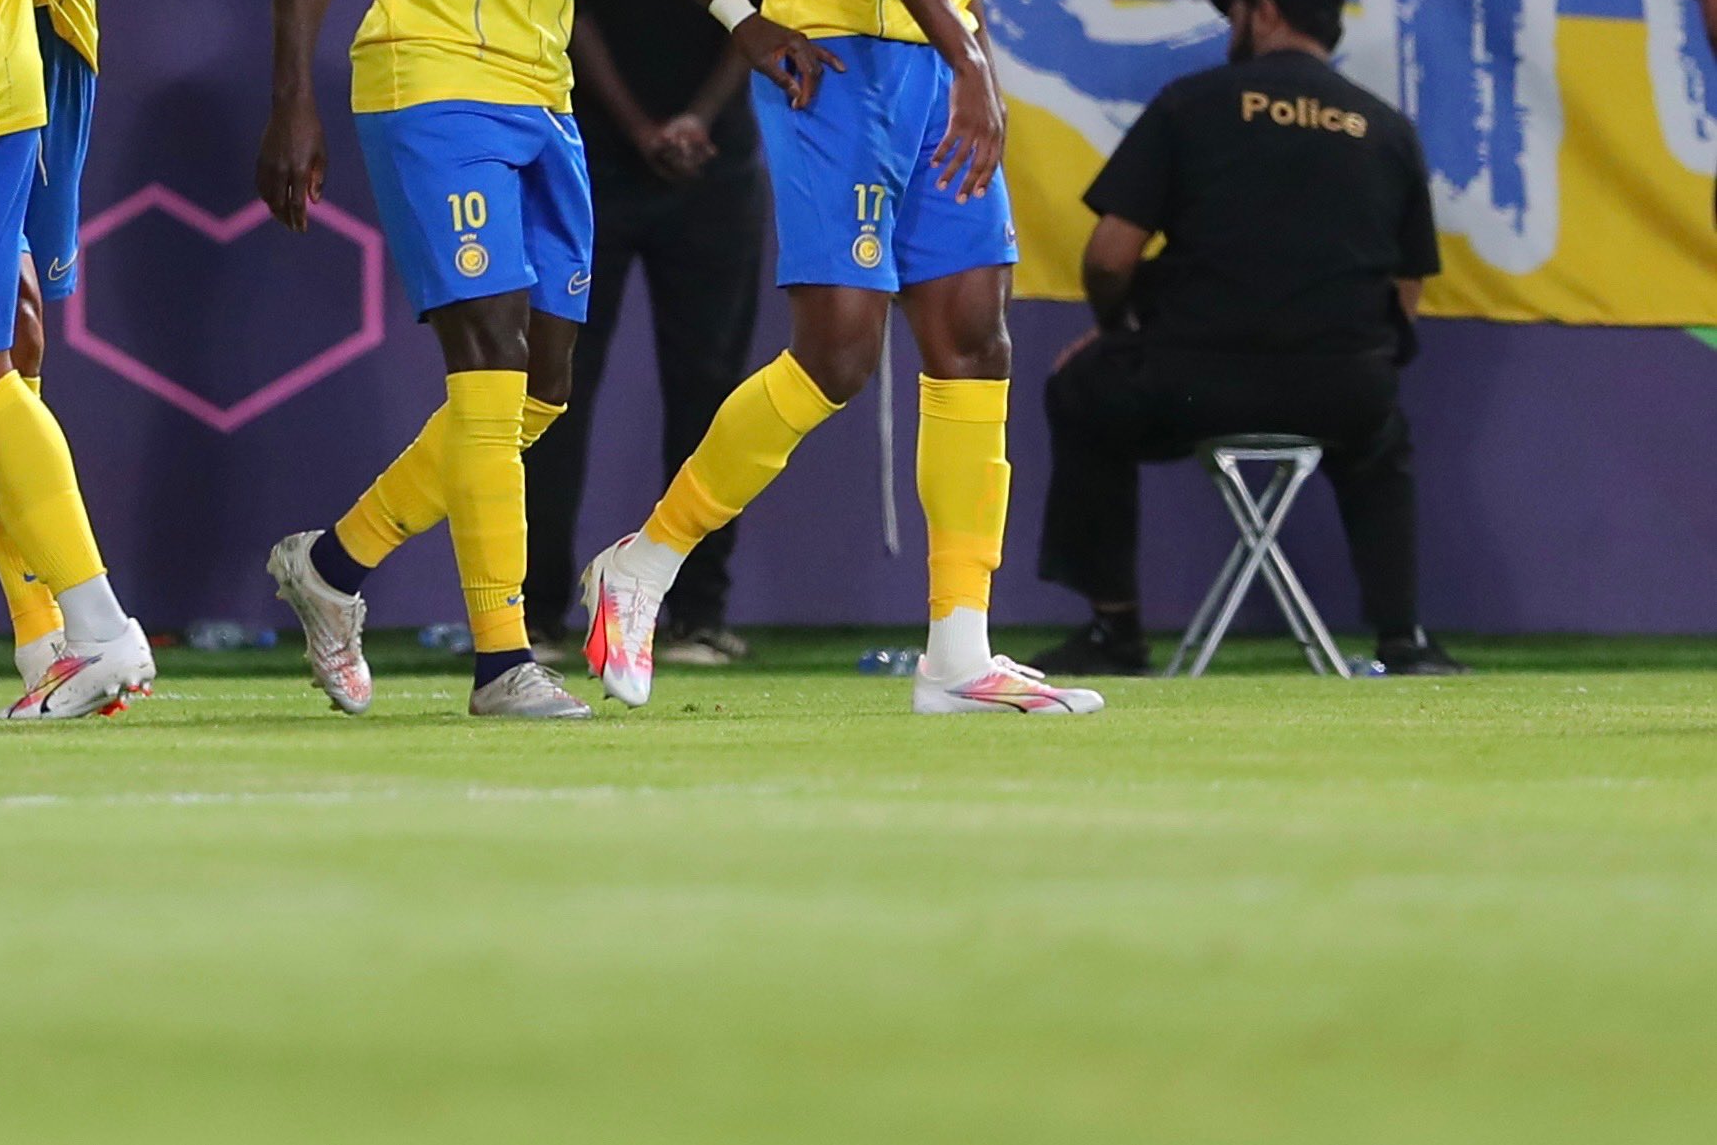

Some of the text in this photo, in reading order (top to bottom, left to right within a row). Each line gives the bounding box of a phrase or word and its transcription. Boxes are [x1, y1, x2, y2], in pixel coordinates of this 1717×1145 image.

[1240, 90, 1369, 139] Police
[446, 190, 488, 232] 10
[853, 183, 886, 222] 17
